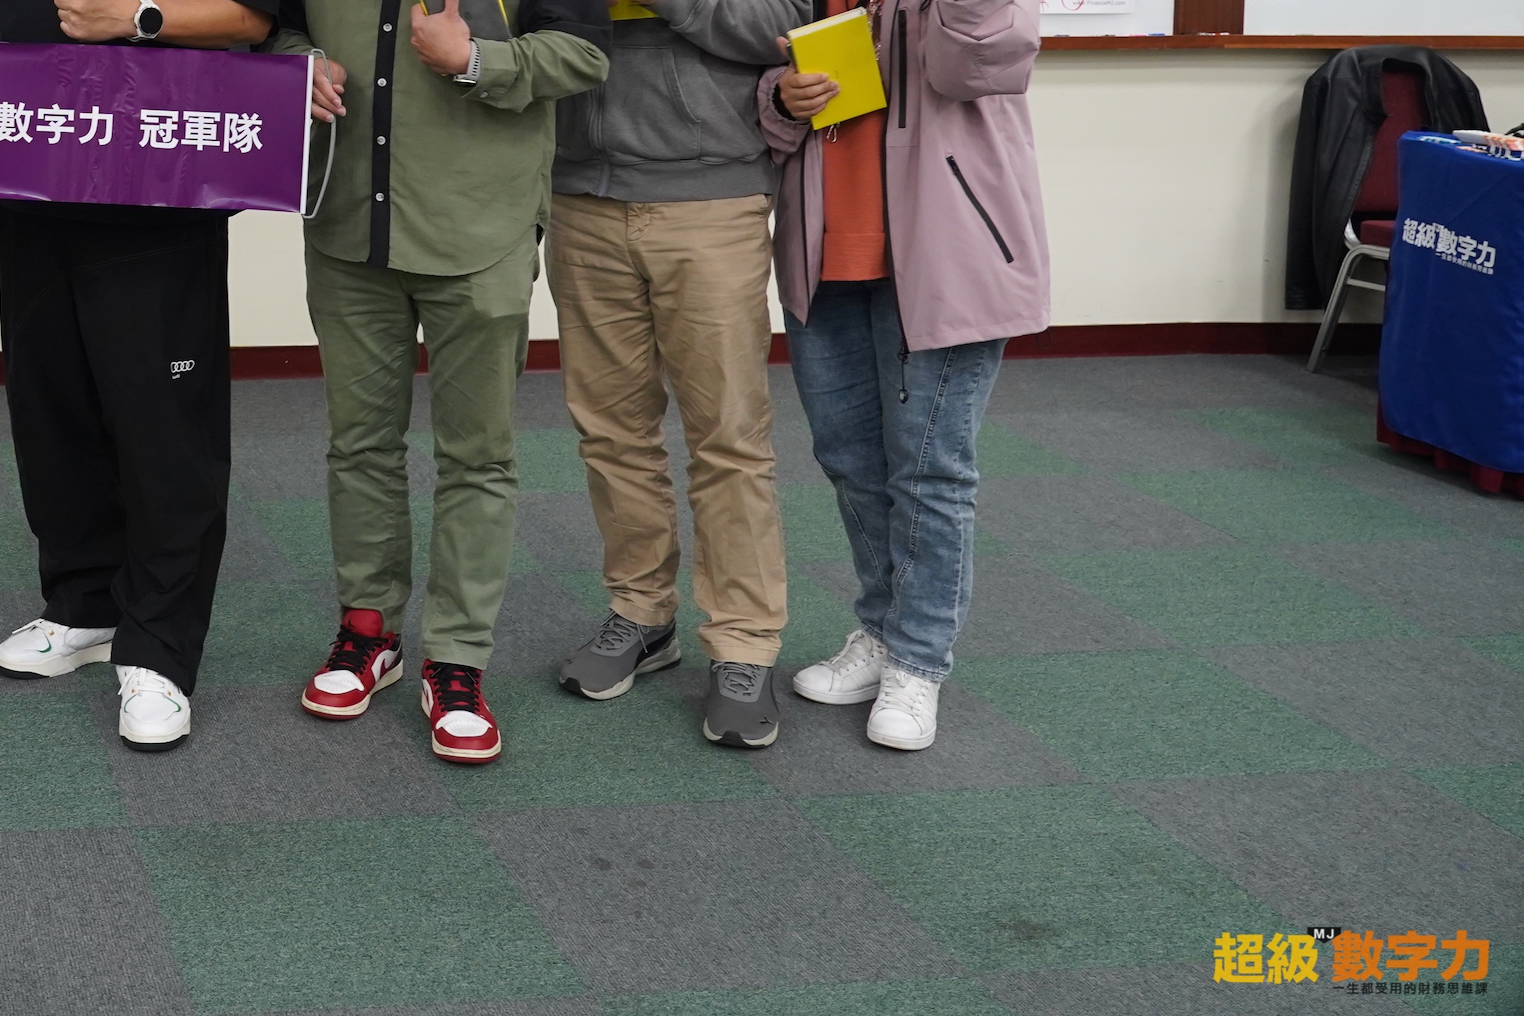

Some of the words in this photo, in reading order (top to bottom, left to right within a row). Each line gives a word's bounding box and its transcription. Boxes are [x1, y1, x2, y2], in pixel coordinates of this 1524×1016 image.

[138, 108, 263, 154] 冠軍隊
[1402, 218, 1496, 268] 超級數字力
